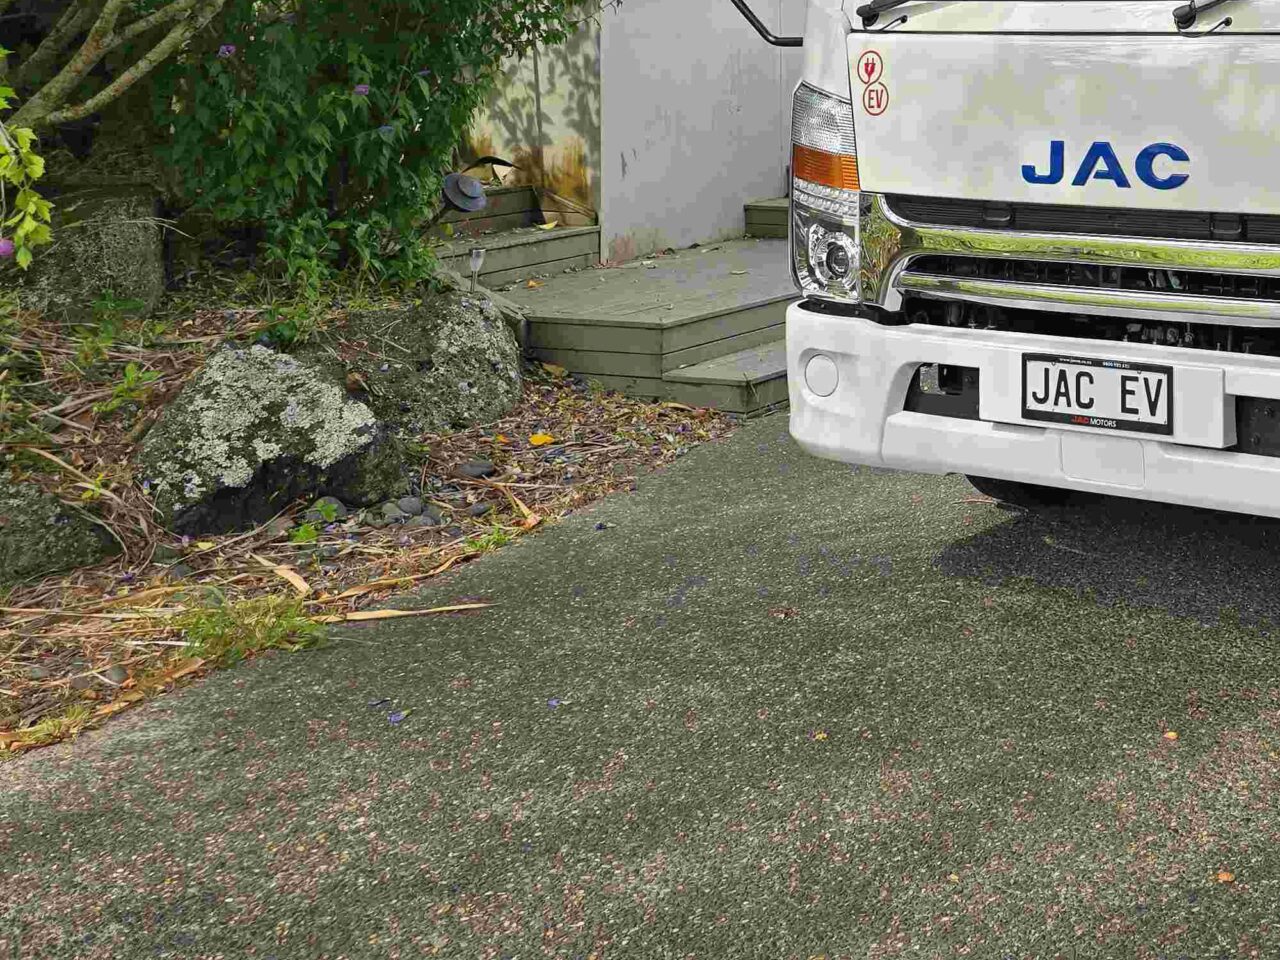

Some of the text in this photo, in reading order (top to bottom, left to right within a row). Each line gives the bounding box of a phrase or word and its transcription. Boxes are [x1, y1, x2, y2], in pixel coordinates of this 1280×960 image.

[868, 89, 884, 109] EV
[1021, 140, 1191, 191] JAC
[1032, 367, 1163, 417] JAC EV
[1090, 417, 1117, 428] MOTORS
